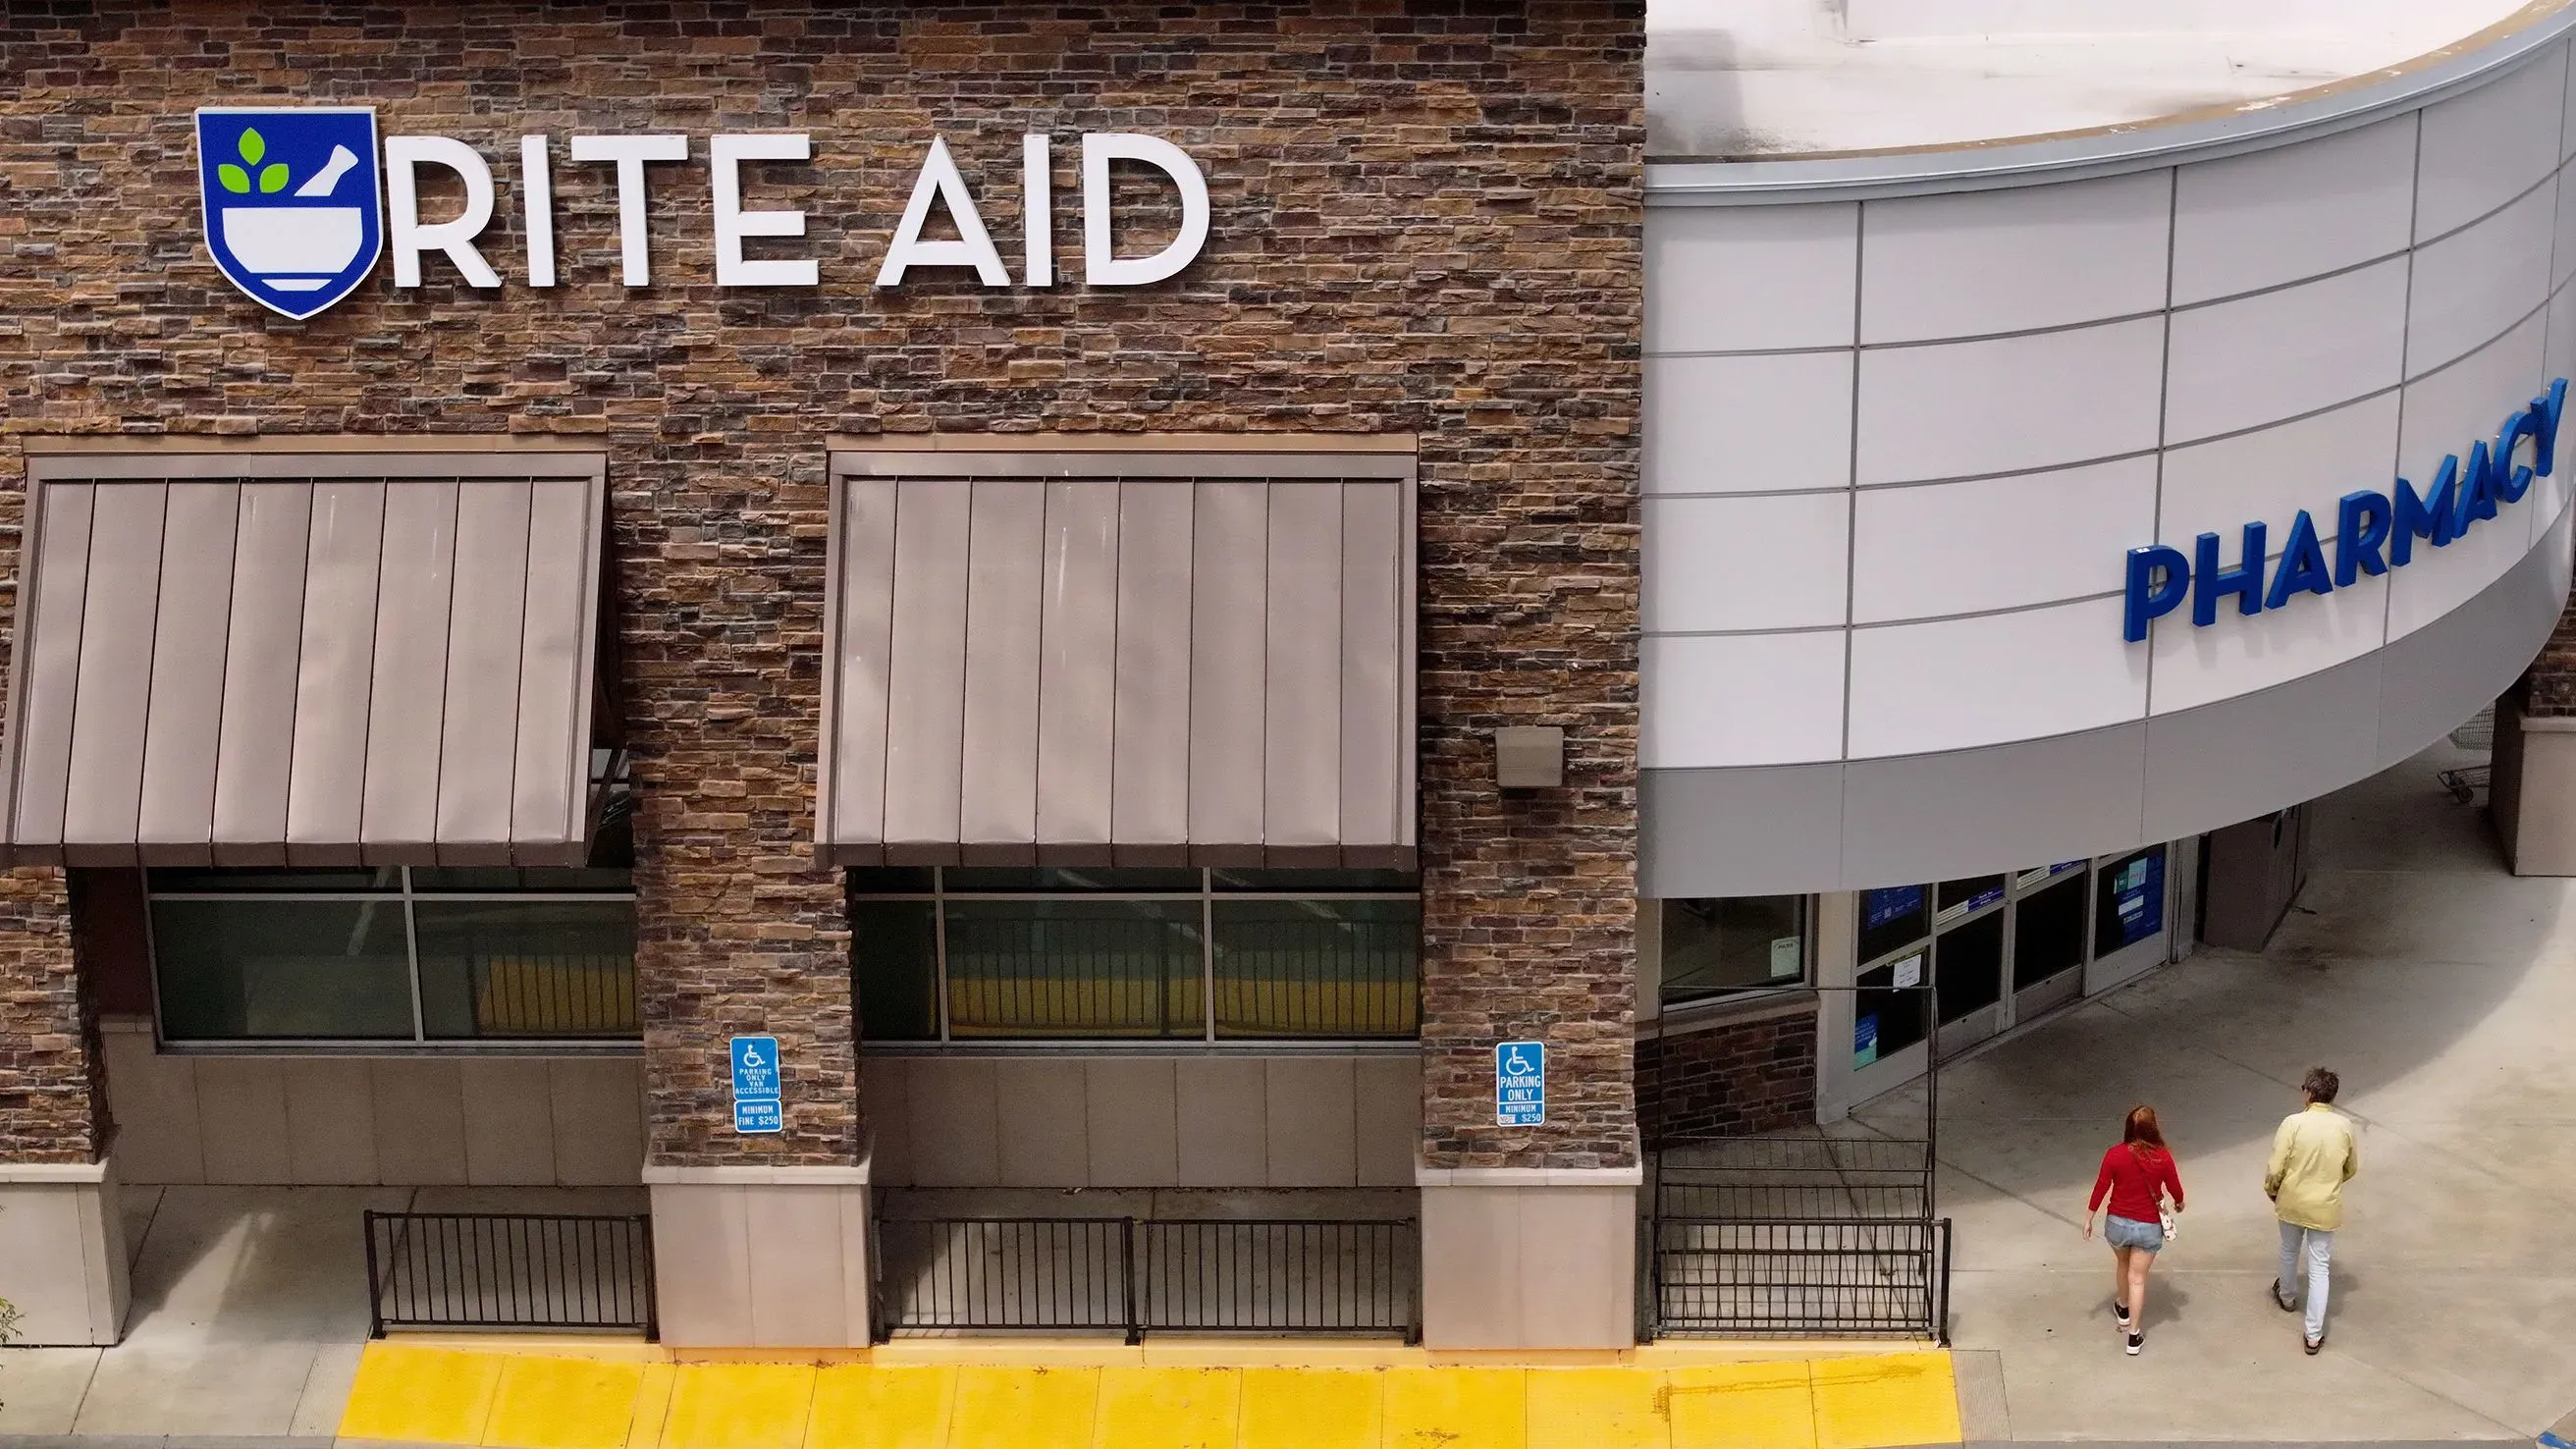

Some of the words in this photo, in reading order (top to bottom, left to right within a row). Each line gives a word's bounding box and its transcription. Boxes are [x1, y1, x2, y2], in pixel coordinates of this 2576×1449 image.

[385, 134, 820, 289] RITE
[875, 132, 1210, 289] AID
[2123, 377, 2568, 643] PHARMACY
[1500, 1076, 1541, 1088] PARKING
[1508, 1089, 1533, 1100] ONLY
[742, 1105, 773, 1114] MINIMUM
[1505, 1104, 1536, 1113] MINIMUM
[738, 1116, 754, 1125] FINE
[758, 1115, 778, 1126] $250
[1522, 1113, 1541, 1122] $250
